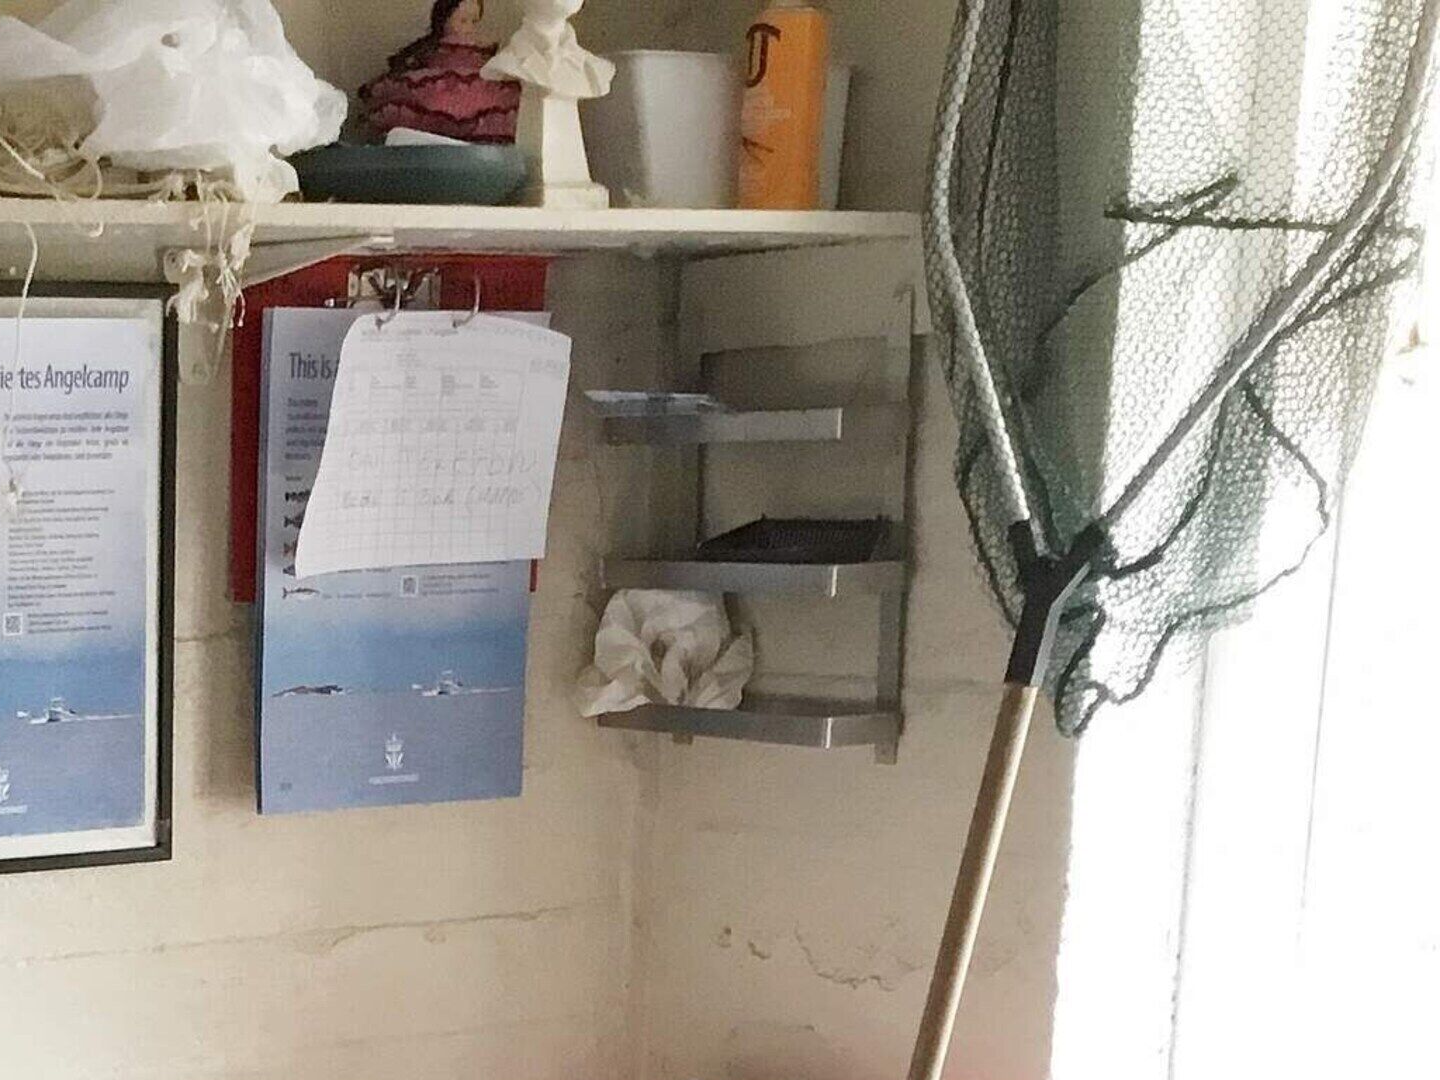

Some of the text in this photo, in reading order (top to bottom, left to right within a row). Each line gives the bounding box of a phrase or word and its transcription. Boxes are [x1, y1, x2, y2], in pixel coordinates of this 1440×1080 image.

[44, 363, 130, 396] Angelcamp
[288, 352, 318, 379] This
[320, 354, 333, 380] is
